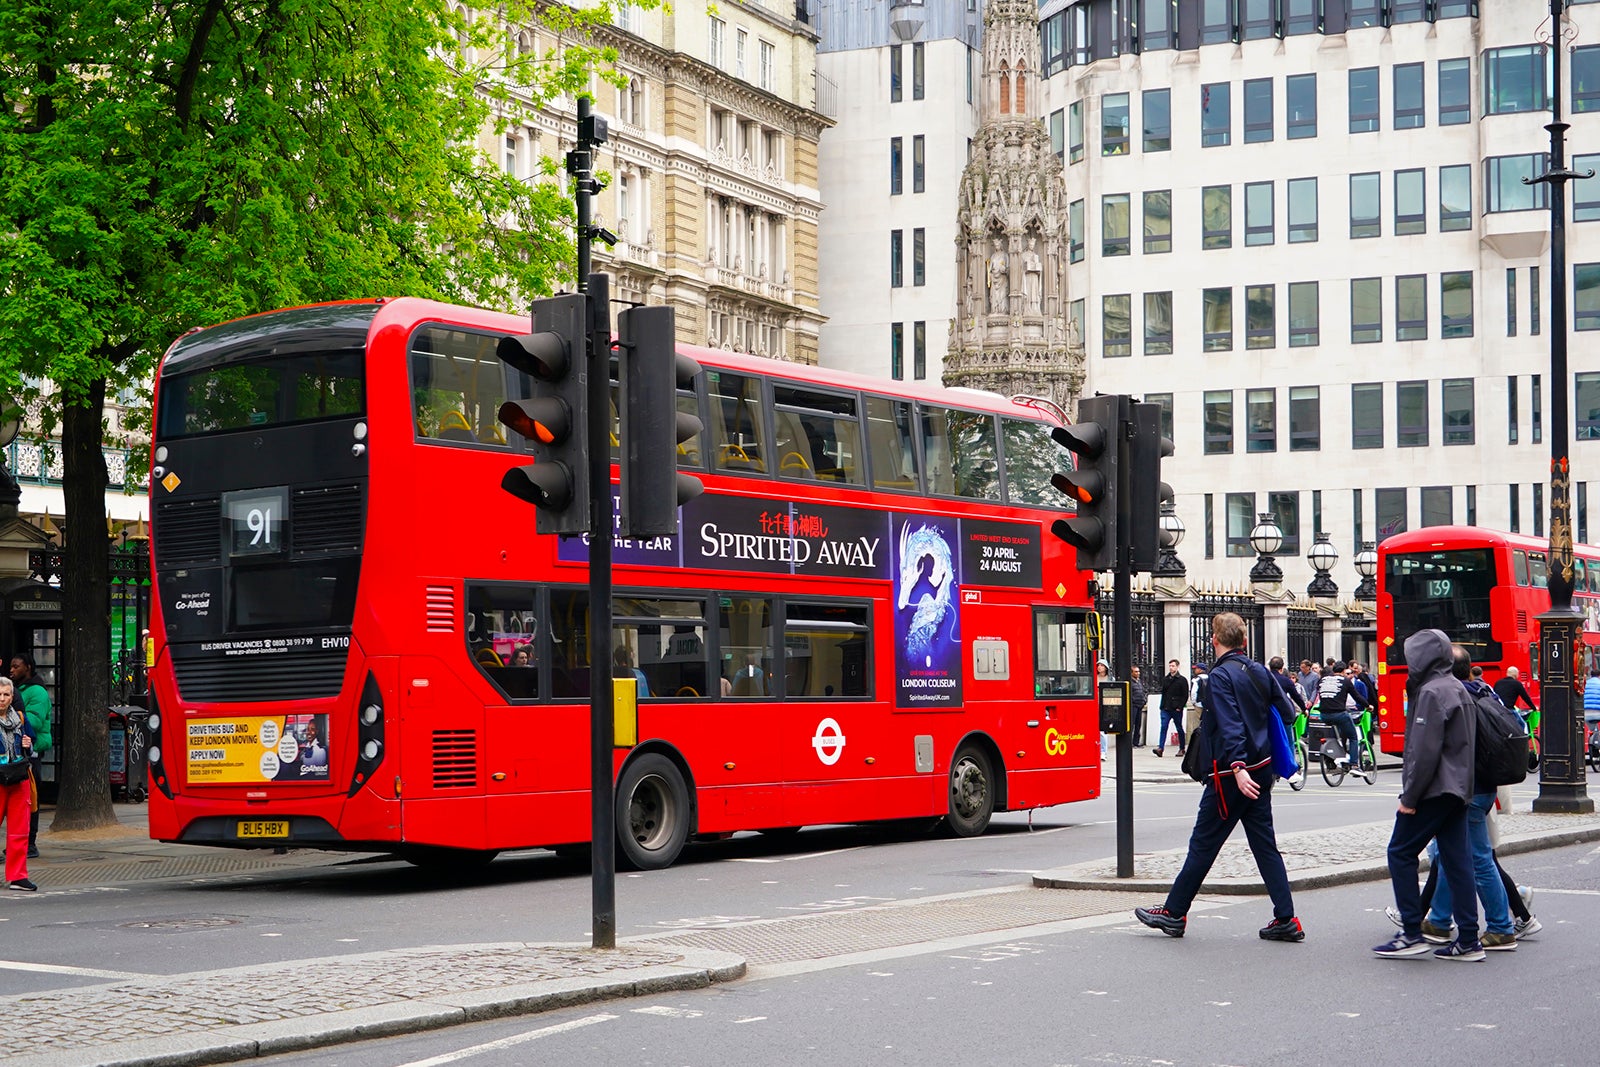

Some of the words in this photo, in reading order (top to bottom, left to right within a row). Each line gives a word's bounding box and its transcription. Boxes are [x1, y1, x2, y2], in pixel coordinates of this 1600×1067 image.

[247, 508, 270, 545] 91
[638, 537, 672, 551] YEAR
[700, 522, 811, 563] SPIRITED
[816, 536, 880, 568] AWAY
[970, 534, 988, 542] LIMITED
[989, 535, 1001, 543] WEST
[1012, 537, 1030, 545] SEASON
[982, 546, 993, 558] 30
[980, 559, 990, 571] 24
[991, 560, 1022, 573] AUGUST
[1429, 579, 1451, 596] 139
[175, 599, 210, 610] Go-Ahead
[212, 642, 232, 650] DRIVER
[232, 640, 263, 649] VACANCIES
[272, 639, 286, 647] 0800
[321, 636, 350, 649] EHV10
[901, 678, 927, 688] LONDON
[928, 678, 956, 688] COLISEUM
[909, 694, 950, 702] SpiritedAwayUK.com
[189, 726, 207, 735] DRIVE
[208, 725, 221, 734] THIS
[222, 724, 234, 734] BUS
[235, 724, 249, 733] AND
[189, 736, 204, 746] KEEP
[205, 735, 231, 745] LONDON
[232, 734, 258, 744] MOVING
[190, 750, 208, 760] APPLY
[209, 750, 225, 759] NOW
[300, 764, 328, 772] GoAhead
[243, 823, 263, 835] BL15
[265, 823, 283, 835] HBX
